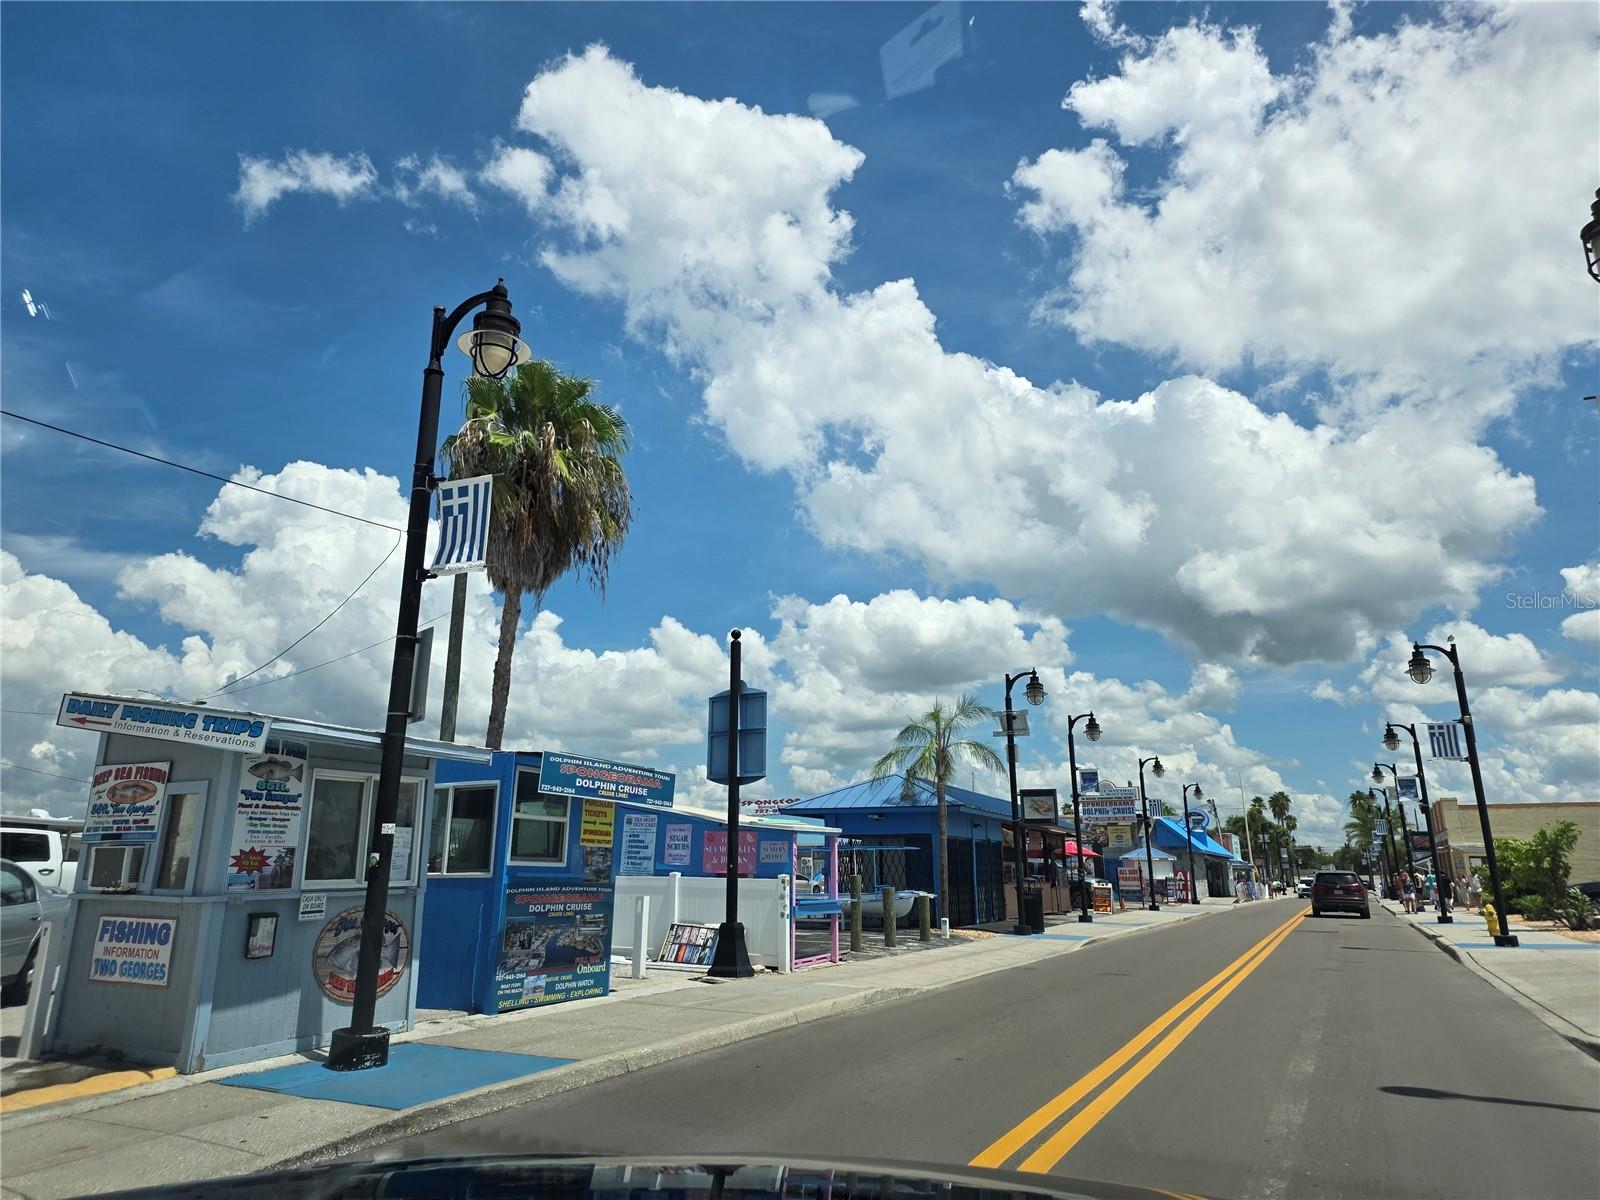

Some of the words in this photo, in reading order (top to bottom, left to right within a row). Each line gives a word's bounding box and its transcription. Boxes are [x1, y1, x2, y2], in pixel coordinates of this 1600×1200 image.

[66, 698, 119, 720] DAILY
[121, 705, 198, 729] FISHING
[202, 714, 265, 738] TRIPS
[114, 721, 169, 736] Information
[173, 728, 180, 737] &
[184, 730, 256, 748] Reservations
[114, 766, 133, 781] SEA
[134, 766, 167, 784] FISHING
[550, 756, 582, 765] DOLPHIN
[583, 760, 611, 769] ISLAND
[613, 765, 654, 777] ADVENTURE
[560, 764, 662, 788] SPONGEORAMA
[576, 778, 617, 791] DOLPHIN
[618, 784, 648, 796] CRUISE
[1082, 807, 1109, 815] DOLPHIN
[1112, 807, 1136, 815] CRUISE
[667, 843, 689, 851] SCRUBS
[669, 834, 688, 842] SUGAR
[1176, 871, 1186, 899] ATM
[529, 904, 565, 913] DOLPHIN
[566, 903, 592, 911] CRUISE
[98, 920, 172, 946] FISHING
[103, 946, 160, 960] INFORMATION
[93, 958, 117, 977] TWO
[120, 961, 166, 981] GEORGES
[577, 962, 606, 974] Onboard
[555, 982, 577, 990] DOLPHIN
[577, 979, 594, 987] WATCH
[498, 997, 530, 1008] SHELLING
[534, 993, 566, 1003] SWIMMING
[569, 987, 603, 998] EXPLORING
